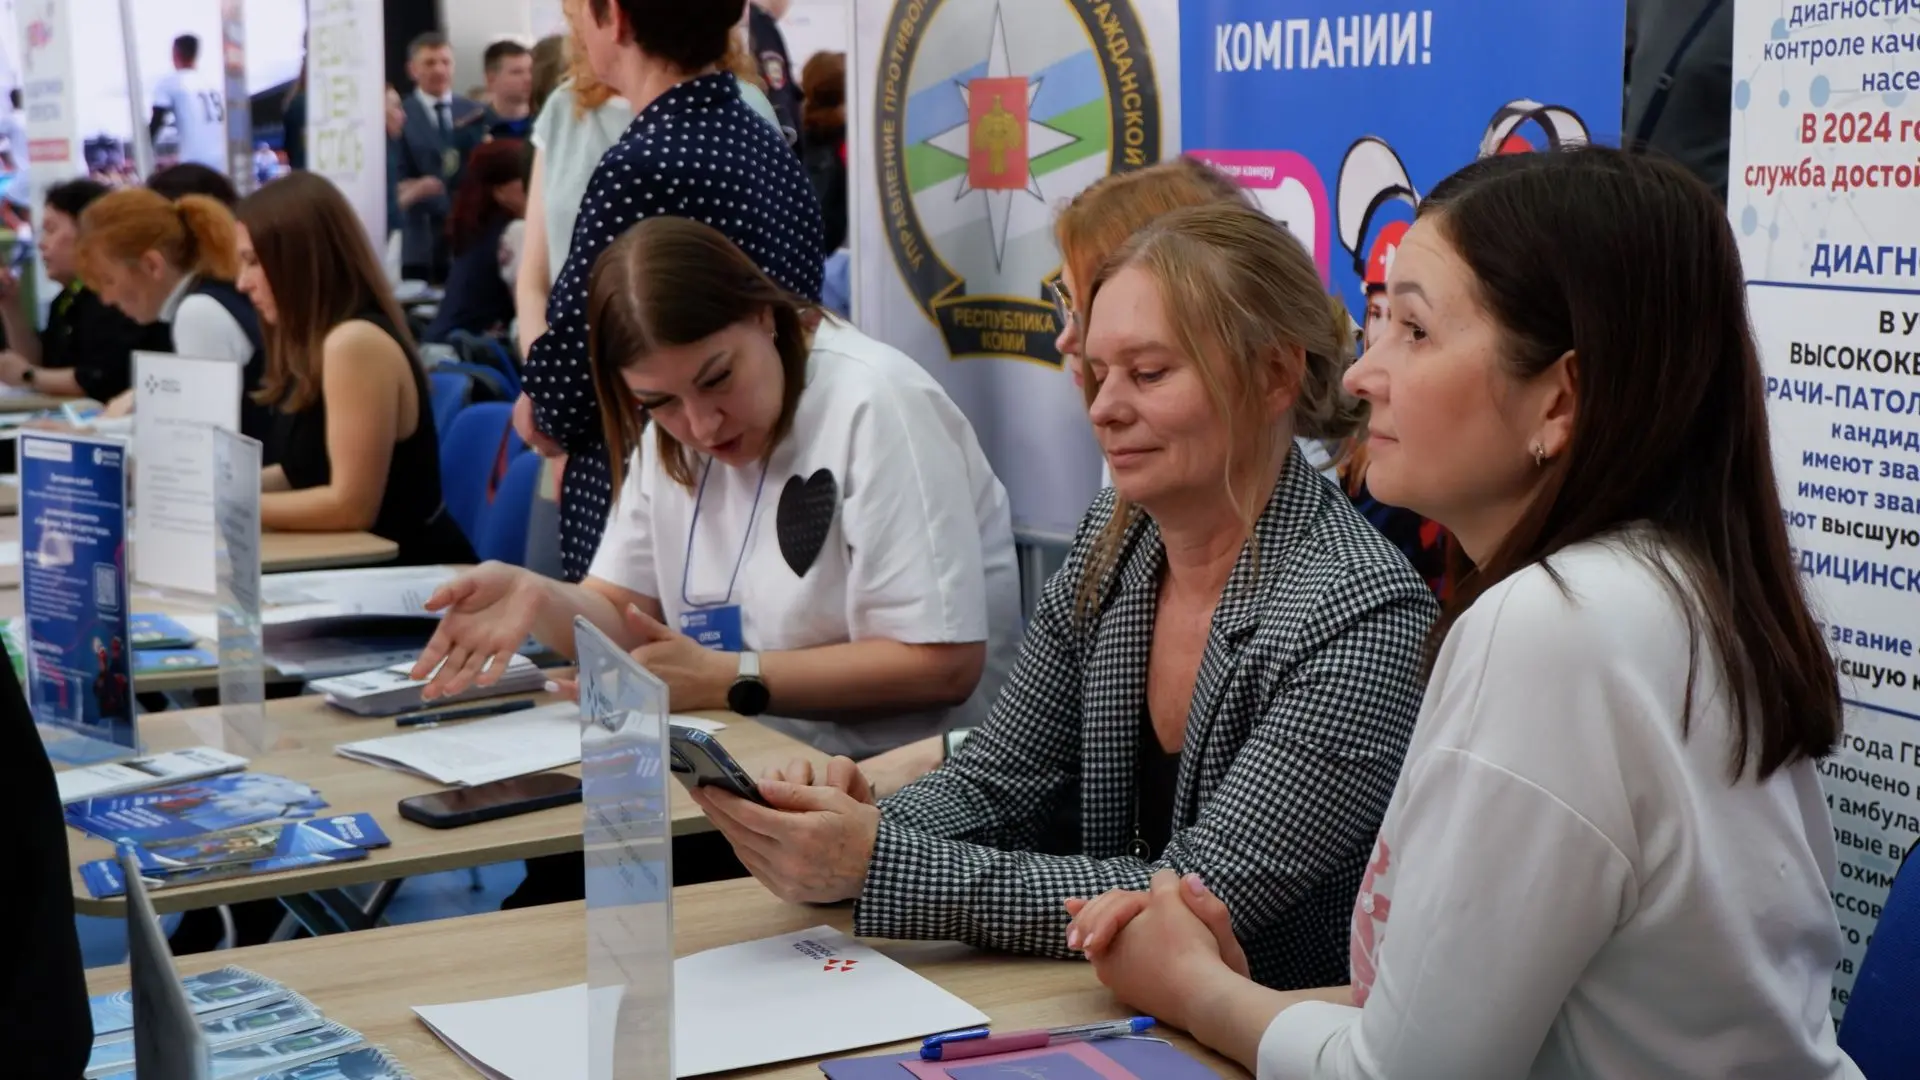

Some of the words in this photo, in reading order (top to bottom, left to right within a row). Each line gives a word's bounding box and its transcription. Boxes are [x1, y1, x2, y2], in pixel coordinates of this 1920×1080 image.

[1215, 10, 1433, 72] КОМПАНИИ!
[1764, 36, 1865, 65] контроле
[1872, 33, 1920, 54] кач
[1089, 0, 1146, 165] АЖДАНСКОЙ
[1801, 113, 1817, 143] В
[1823, 112, 1892, 143] 2024
[1745, 157, 1826, 195] служба
[1811, 244, 1920, 278] ДИАГН
[953, 307, 1057, 333] РЕСПУБЛИКА
[1879, 310, 1895, 334] В
[981, 331, 1026, 353] КОМИ
[1766, 376, 1920, 416] РАЧИ-ПАТОЛ
[1802, 450, 1874, 476] имеют
[1798, 481, 1869, 507] имеют
[1822, 516, 1920, 550] высшую
[1792, 547, 1920, 595] ДИЦИНСК
[1831, 624, 1912, 657] звание
[1843, 733, 1893, 760] года
[1815, 759, 1910, 797] ключено
[1838, 861, 1894, 889] охим
